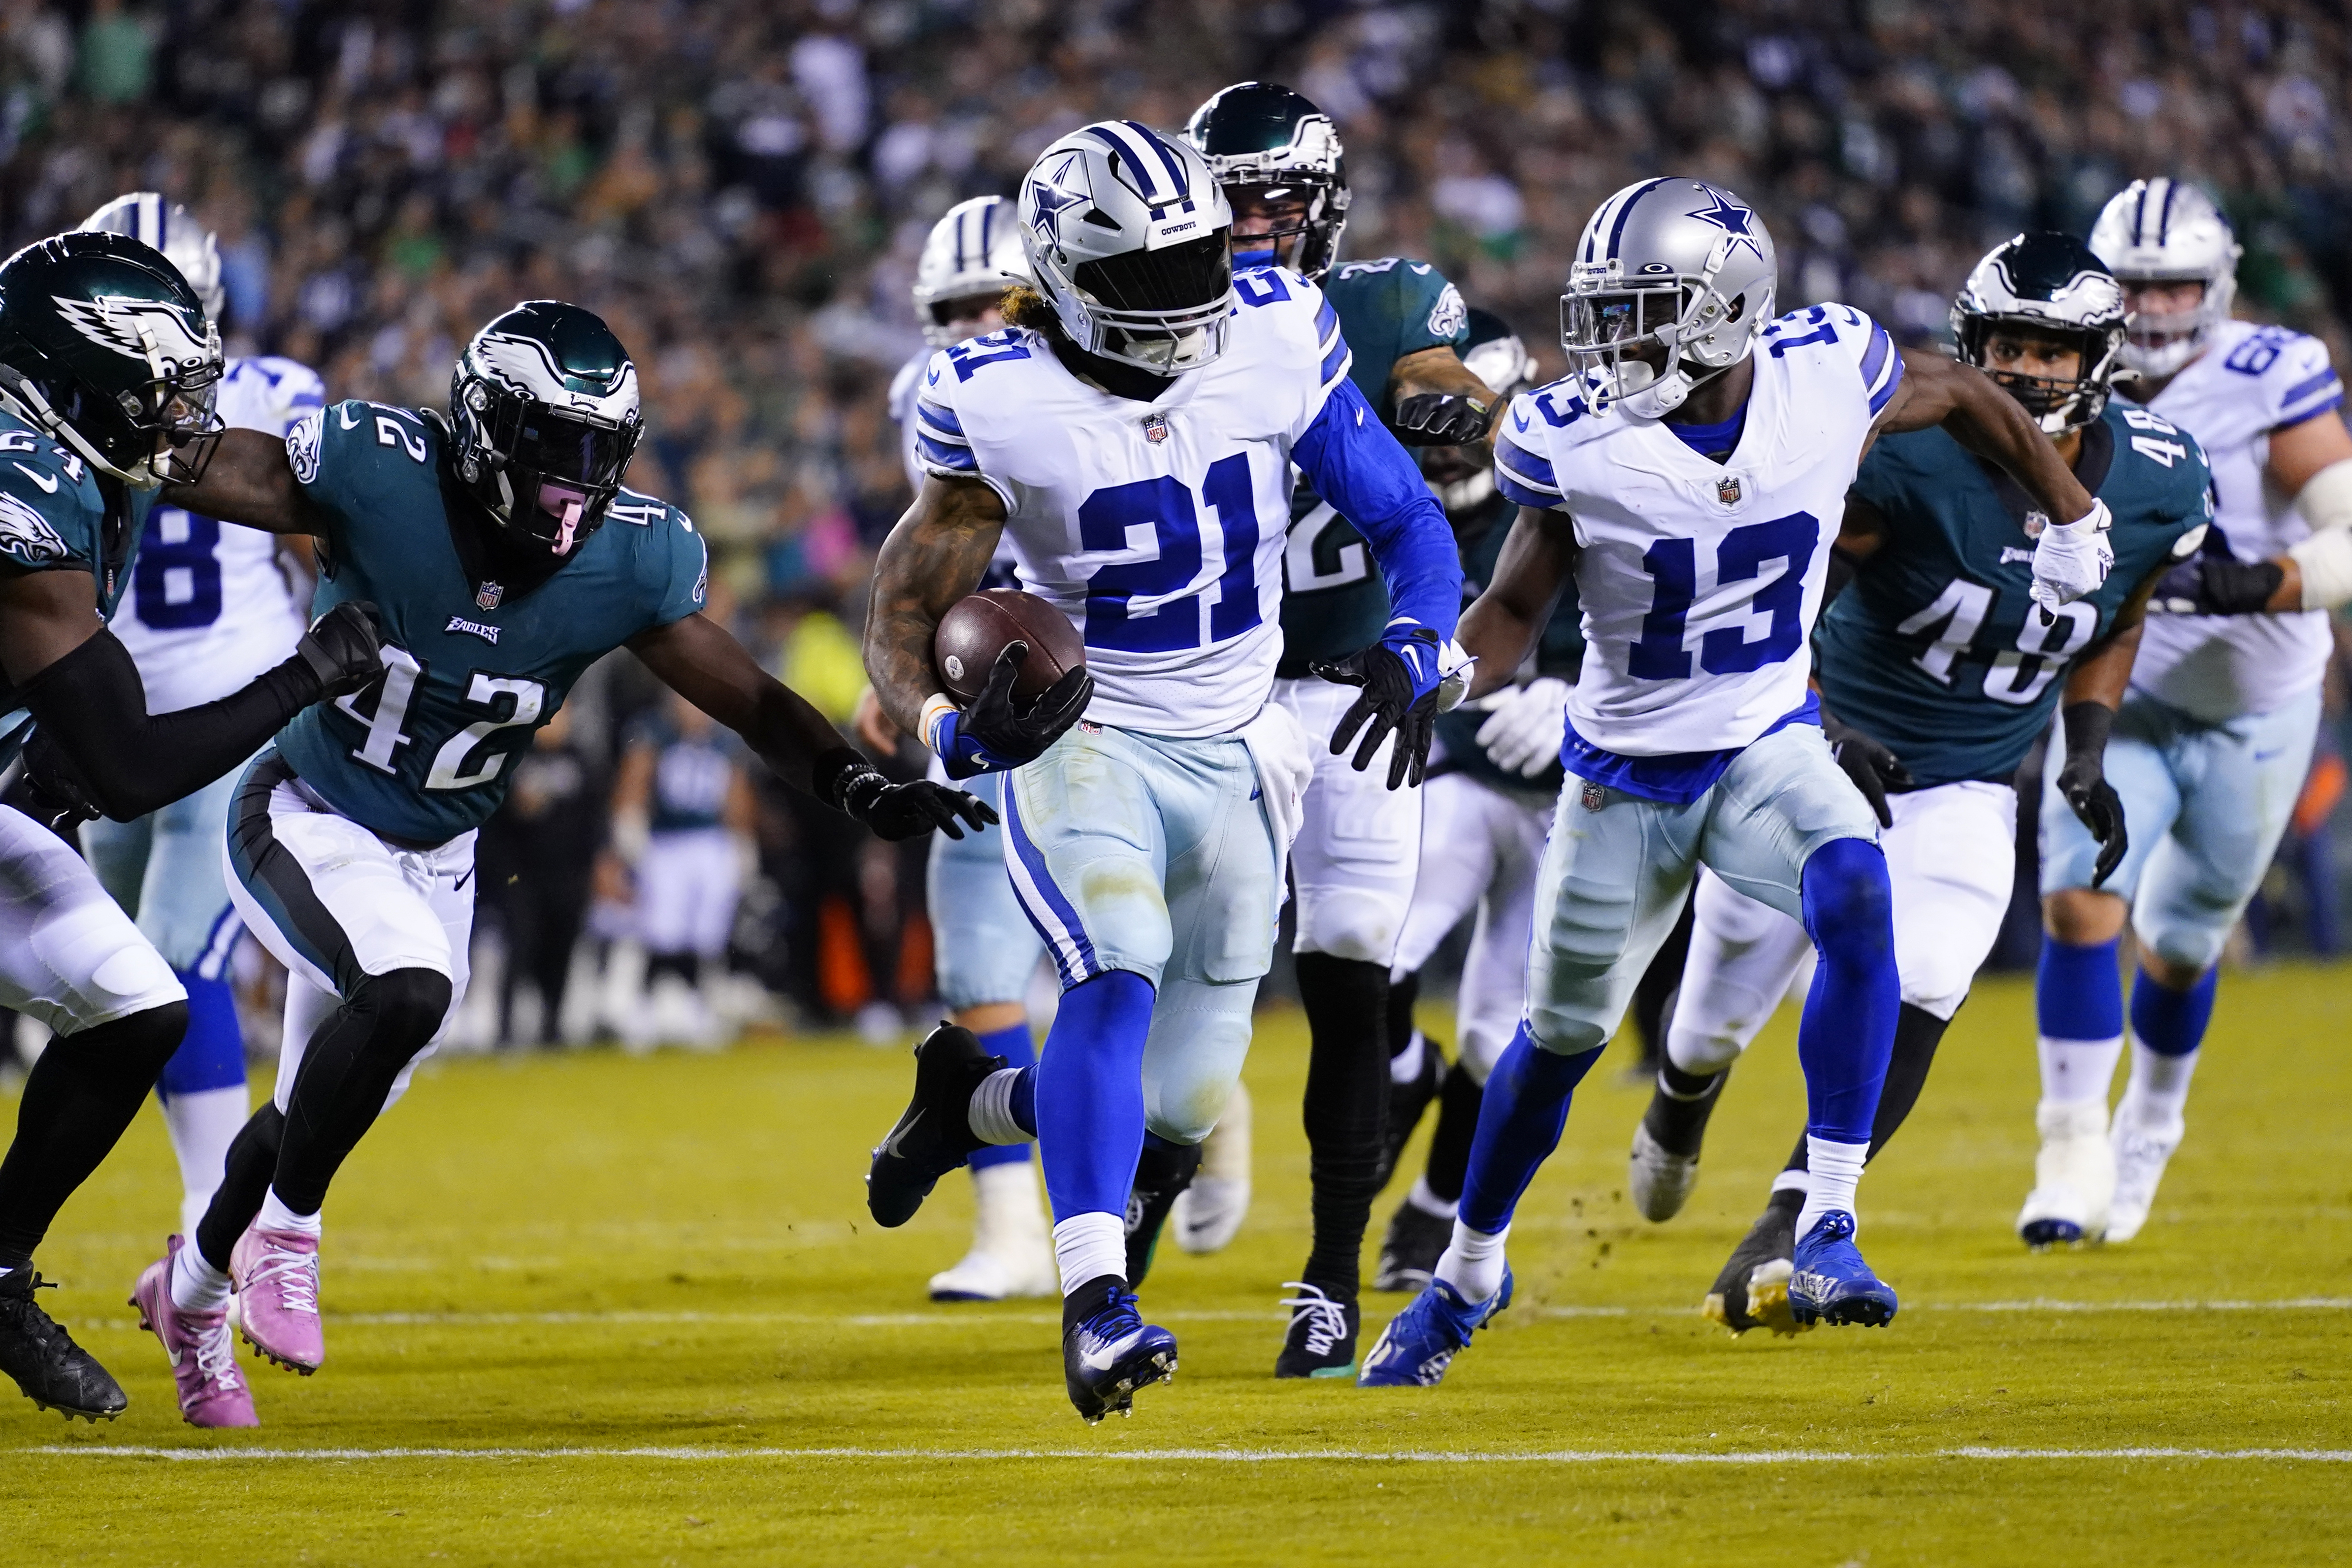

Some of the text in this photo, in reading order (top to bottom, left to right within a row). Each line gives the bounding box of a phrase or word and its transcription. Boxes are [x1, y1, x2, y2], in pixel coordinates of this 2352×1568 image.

[1161, 221, 1197, 235] COWBOYS
[1230, 266, 1292, 316] 2
[1528, 371, 1609, 428] 3
[1148, 427, 1166, 439] NFL
[609, 486, 667, 526] 4
[1721, 489, 1738, 501] NFL
[1078, 451, 1262, 653] 21
[480, 593, 496, 606] NFL
[1627, 510, 1820, 681] 13
[444, 615, 502, 645] EAGLES
[1896, 578, 2101, 705] 48
[334, 643, 546, 790] 42
[1584, 794, 1600, 807] NFL
